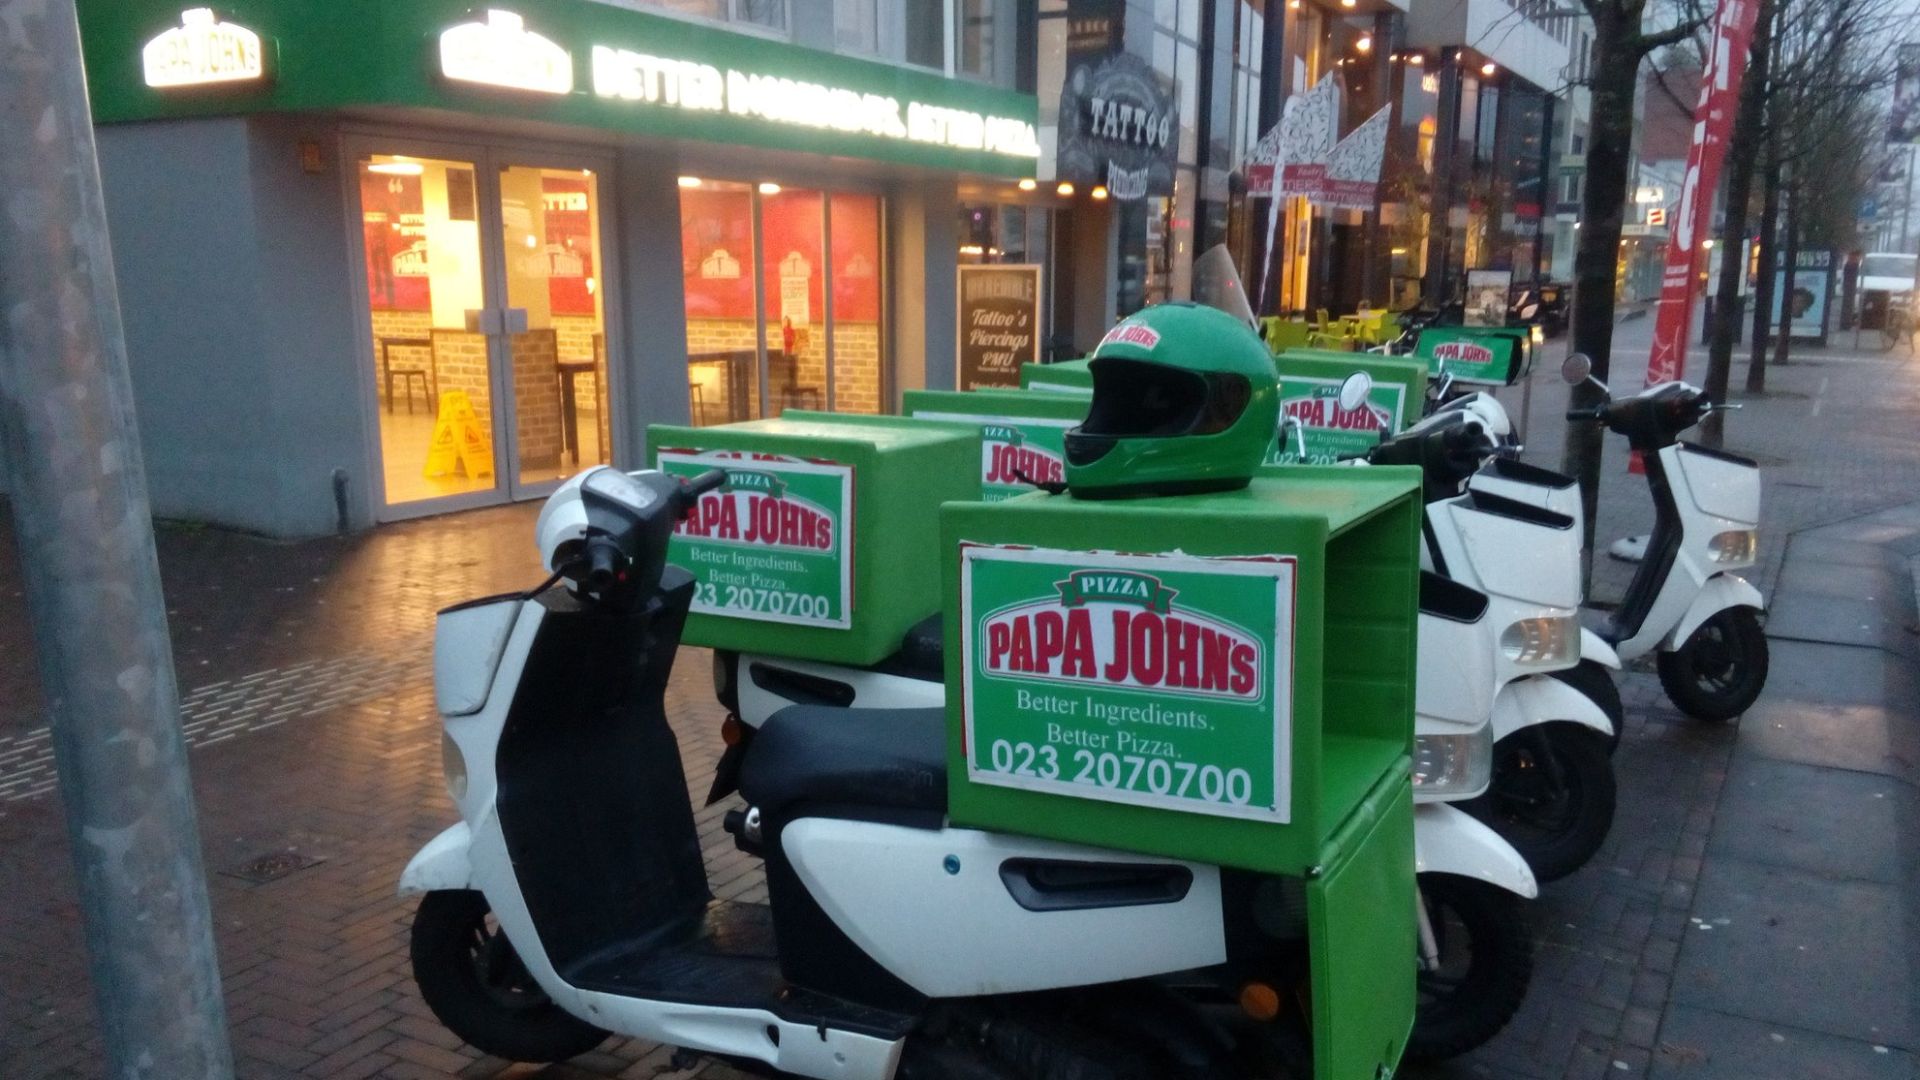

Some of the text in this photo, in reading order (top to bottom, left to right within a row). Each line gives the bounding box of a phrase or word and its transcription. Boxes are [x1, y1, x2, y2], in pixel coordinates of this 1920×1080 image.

[1091, 98, 1169, 149] TATTOO
[972, 309, 1027, 327] Tattoo's
[970, 329, 1028, 351] Piercings
[984, 427, 1012, 438] IZZA
[730, 473, 770, 488] PIZZA
[744, 496, 831, 549] JOHN'S
[691, 547, 808, 573] Better Ingredients.
[709, 568, 790, 591] Better Pizza.
[1081, 576, 1149, 598] PIZZA
[688, 582, 829, 620] 23 2070700
[988, 608, 1255, 695] PAPA JOHN'S
[1017, 689, 1215, 731] Better Ingredients.
[1047, 722, 1182, 759] Better Pizza.
[991, 738, 1061, 780] 023
[1073, 749, 1252, 805] 2070700
